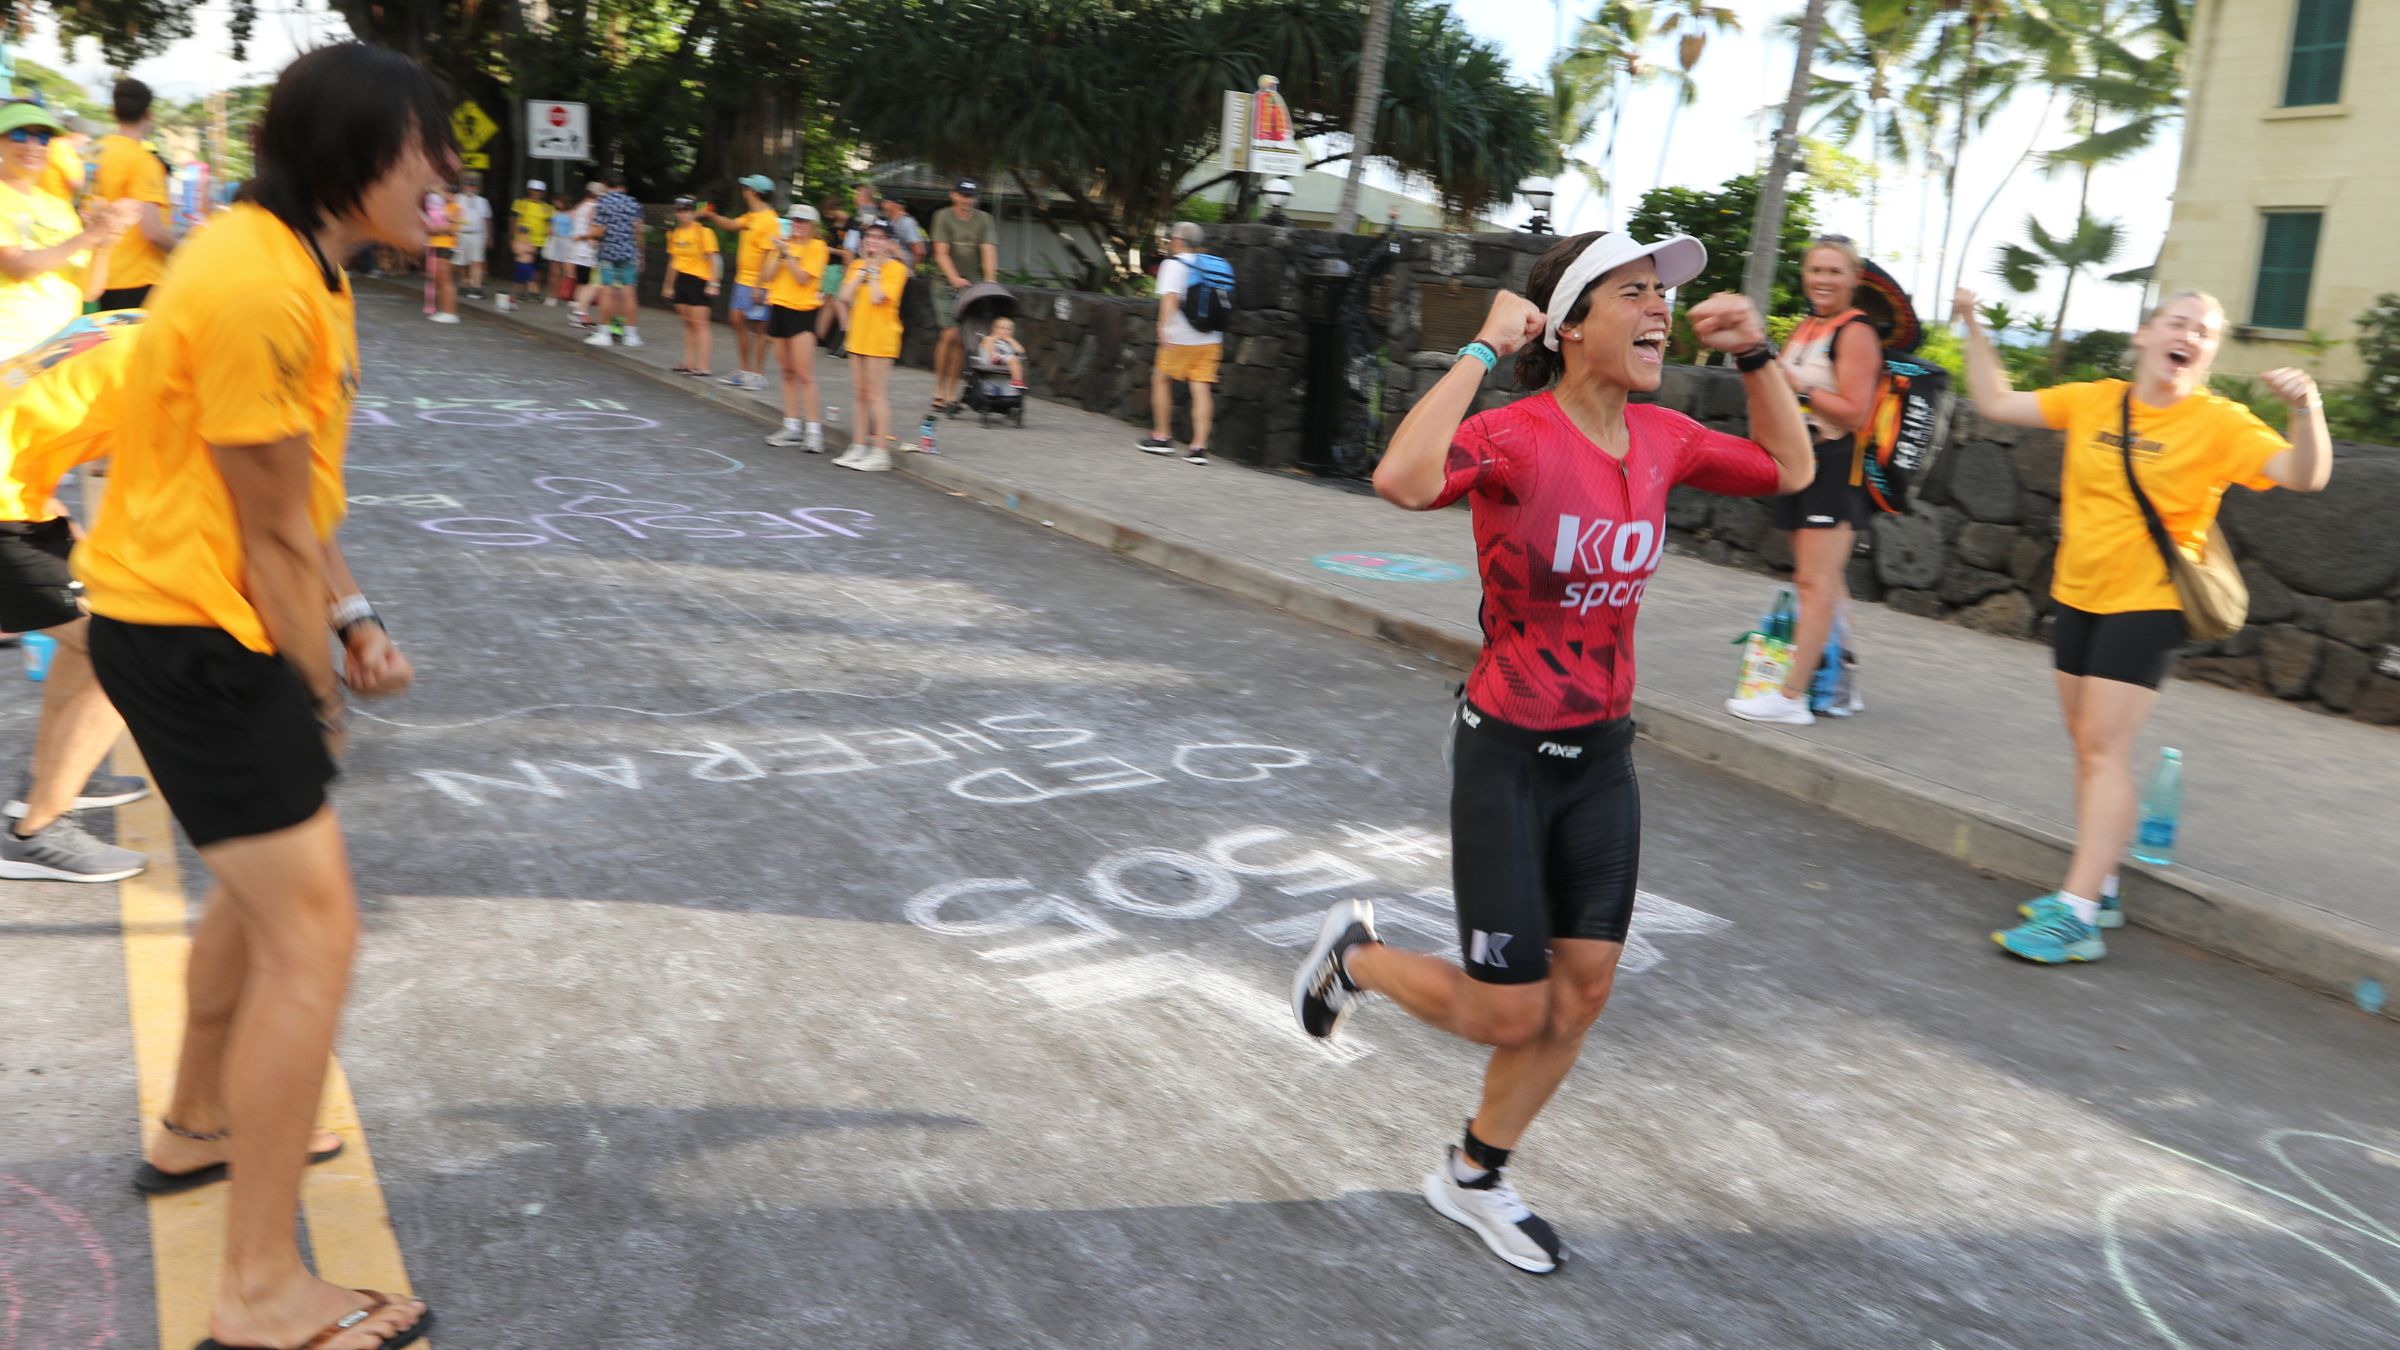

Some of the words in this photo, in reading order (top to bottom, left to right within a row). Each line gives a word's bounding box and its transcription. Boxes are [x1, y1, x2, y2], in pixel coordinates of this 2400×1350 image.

[418, 506, 876, 546] JESUS
[412, 711, 1097, 808] SHEERAN
[946, 754, 1168, 805] ED
